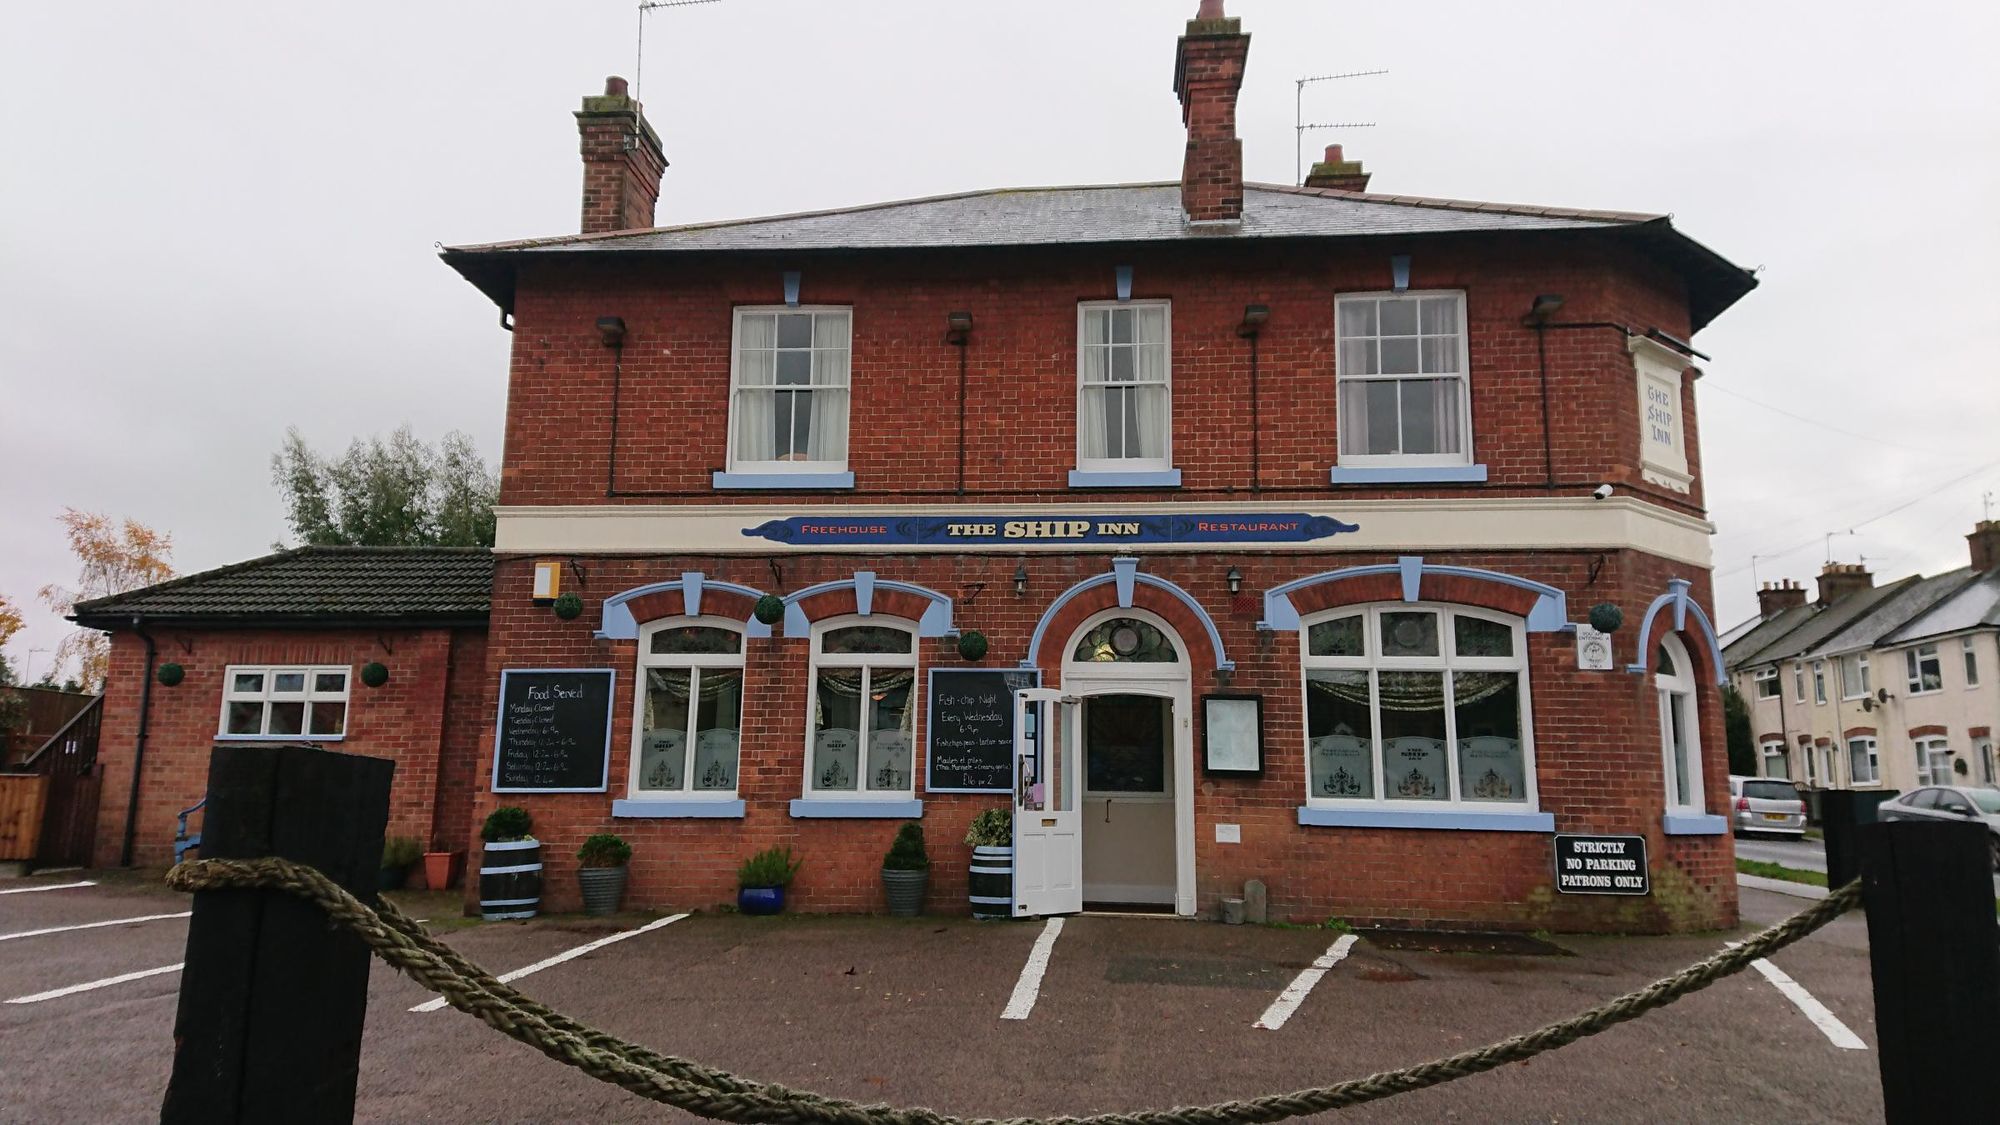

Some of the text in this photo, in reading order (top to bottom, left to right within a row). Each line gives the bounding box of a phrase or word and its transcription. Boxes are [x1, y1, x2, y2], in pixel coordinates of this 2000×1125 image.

[1648, 404, 1672, 427] SHIP
[1651, 423, 1671, 446] INN
[801, 524, 887, 534] FREEHOUSE
[947, 520, 1140, 538] THE SHIP INN
[1198, 521, 1299, 532] RESTAURANT
[528, 683, 583, 700] Food Served
[938, 693, 955, 706] Fish
[978, 693, 997, 708] Night
[509, 700, 555, 716] Monday Closed
[941, 709, 1004, 727] Every Wednesday
[507, 748, 529, 760] Friday
[504, 772, 529, 783] Sunday
[1573, 841, 1626, 854] STRICTLY
[1566, 858, 1637, 871] NO PARKING
[1561, 874, 1644, 888] PATRONS ONLY
